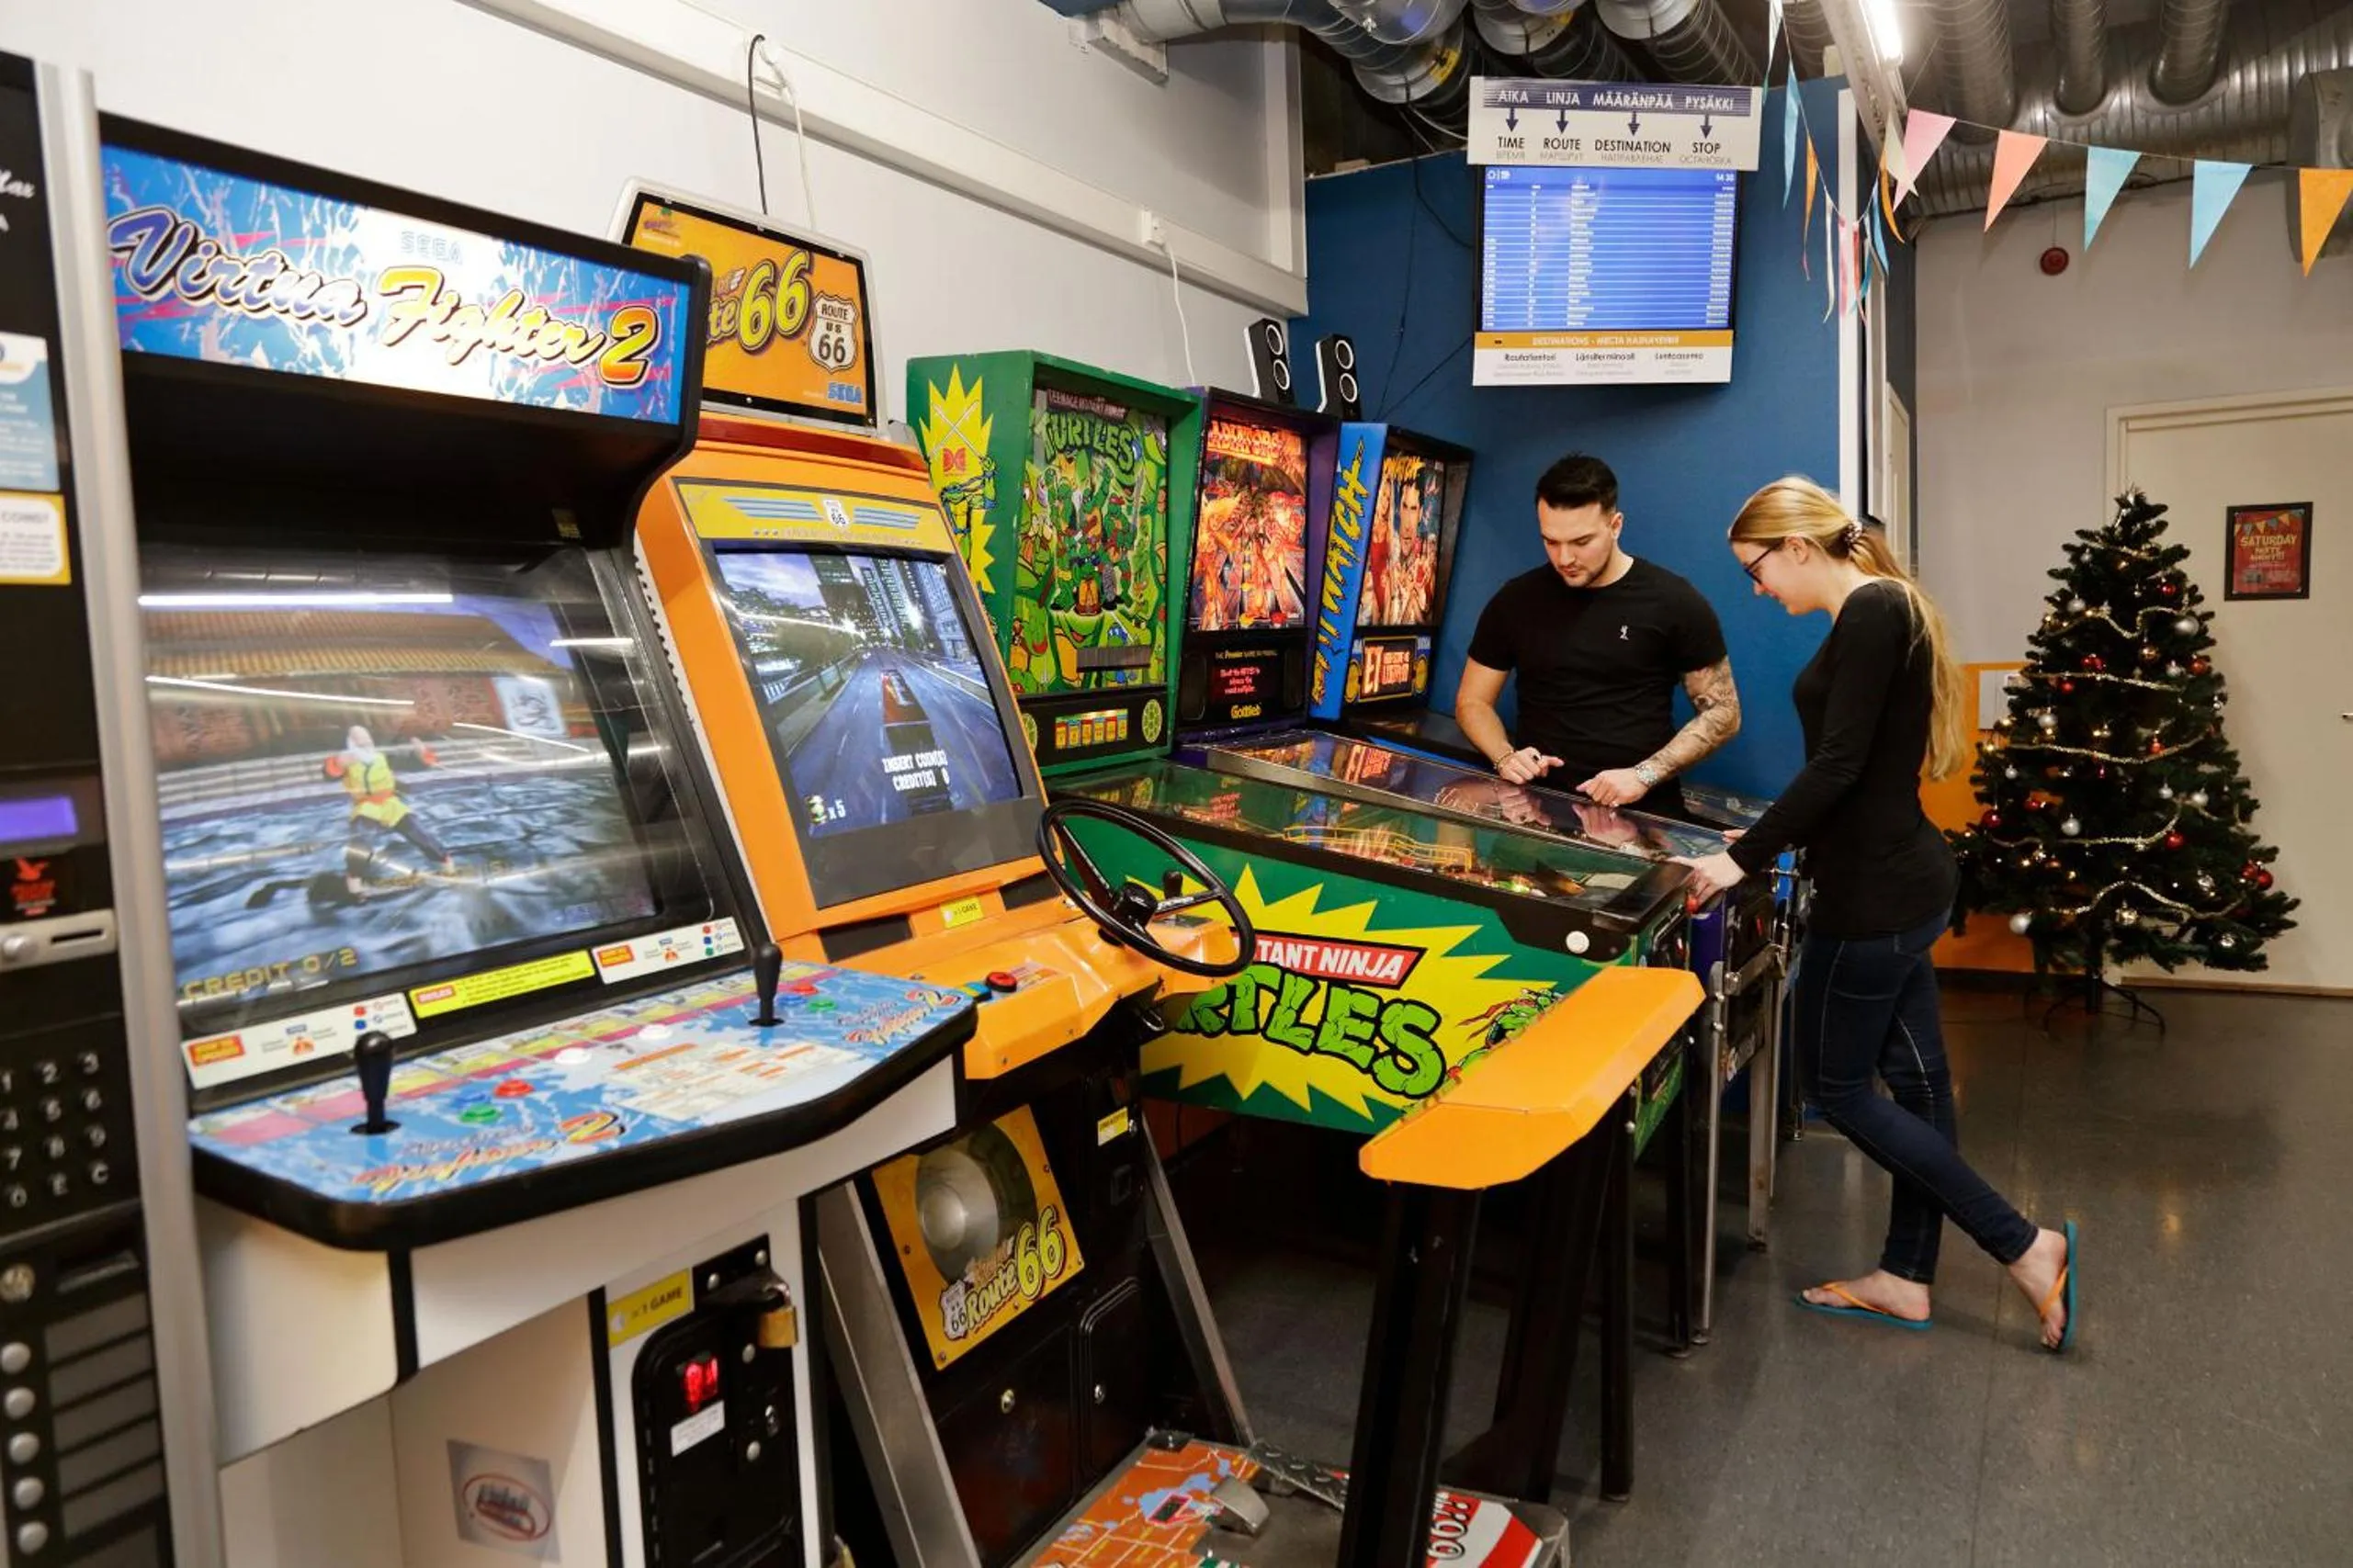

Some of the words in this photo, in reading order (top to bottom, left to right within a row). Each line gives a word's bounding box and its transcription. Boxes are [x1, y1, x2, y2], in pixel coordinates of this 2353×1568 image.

[1498, 91, 1529, 104] AIKA
[1545, 92, 1580, 106] LINJA
[1592, 91, 1673, 109] MÄÄRÄNPÄÄ
[1685, 95, 1734, 111] PYSÄKKI
[1498, 136, 1525, 149] TIME
[1544, 138, 1580, 150] ROUTE
[1595, 140, 1671, 153] DESTINATION
[1692, 142, 1721, 154] STOP
[401, 230, 462, 265] SEGA
[107, 206, 368, 329] Virtua
[376, 266, 607, 367] Fighter
[598, 306, 661, 388] 2
[738, 249, 812, 355] 66
[820, 304, 849, 321] ROUTE
[818, 333, 846, 364] 66
[827, 382, 863, 404] SEGA
[1035, 411, 1135, 474] TURTLES
[2240, 534, 2297, 547] SATURDAY
[1318, 947, 1405, 980] NINJA
[184, 963, 290, 999] CREDIT
[45, 1061, 60, 1085] 2
[964, 1258, 1019, 1331] Route
[1015, 1205, 1067, 1300] 66
[650, 1287, 682, 1311] GAME
